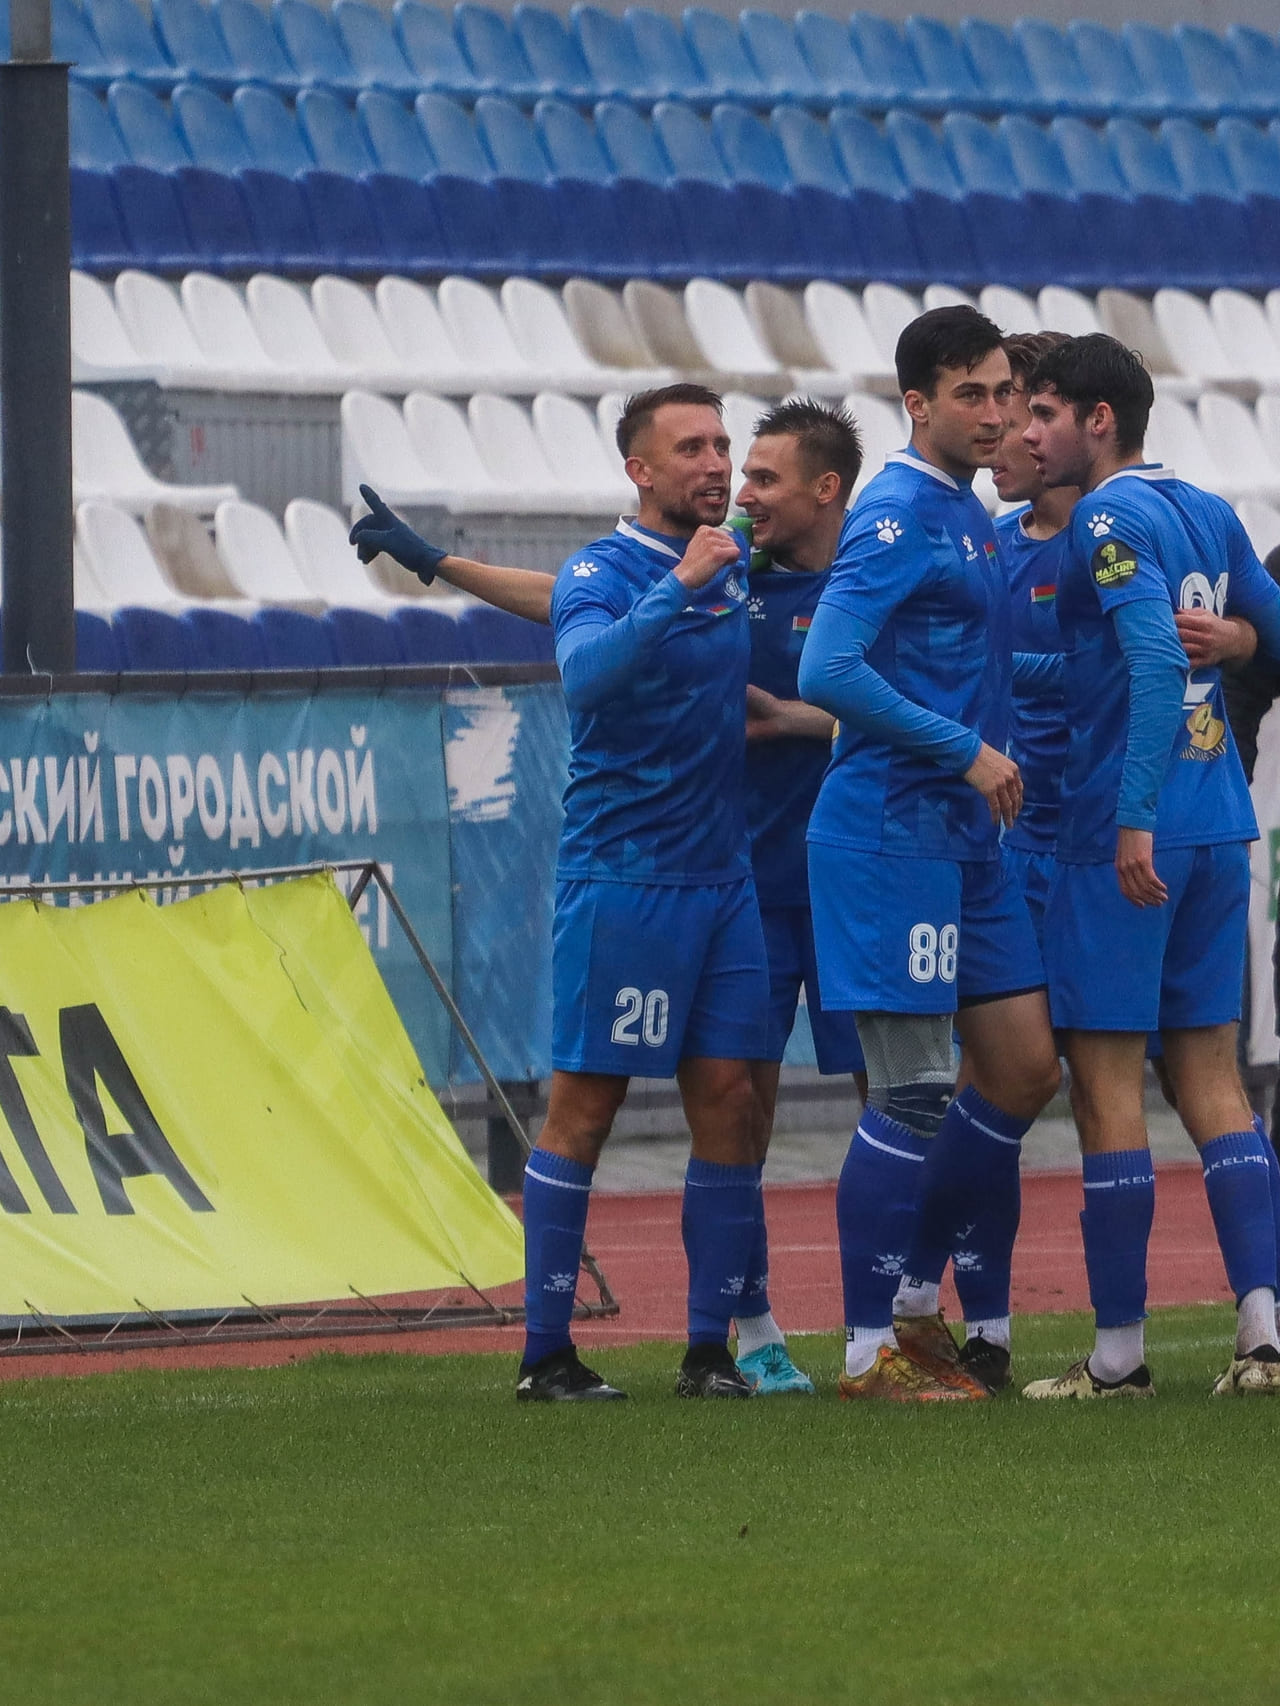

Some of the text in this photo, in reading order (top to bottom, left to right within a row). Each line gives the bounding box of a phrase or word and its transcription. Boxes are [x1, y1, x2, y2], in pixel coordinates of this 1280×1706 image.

[114, 724, 377, 850] ГОРОДСКОЙ
[908, 923, 959, 984] 88
[611, 987, 669, 1048] 20
[1211, 1156, 1263, 1171] KELME
